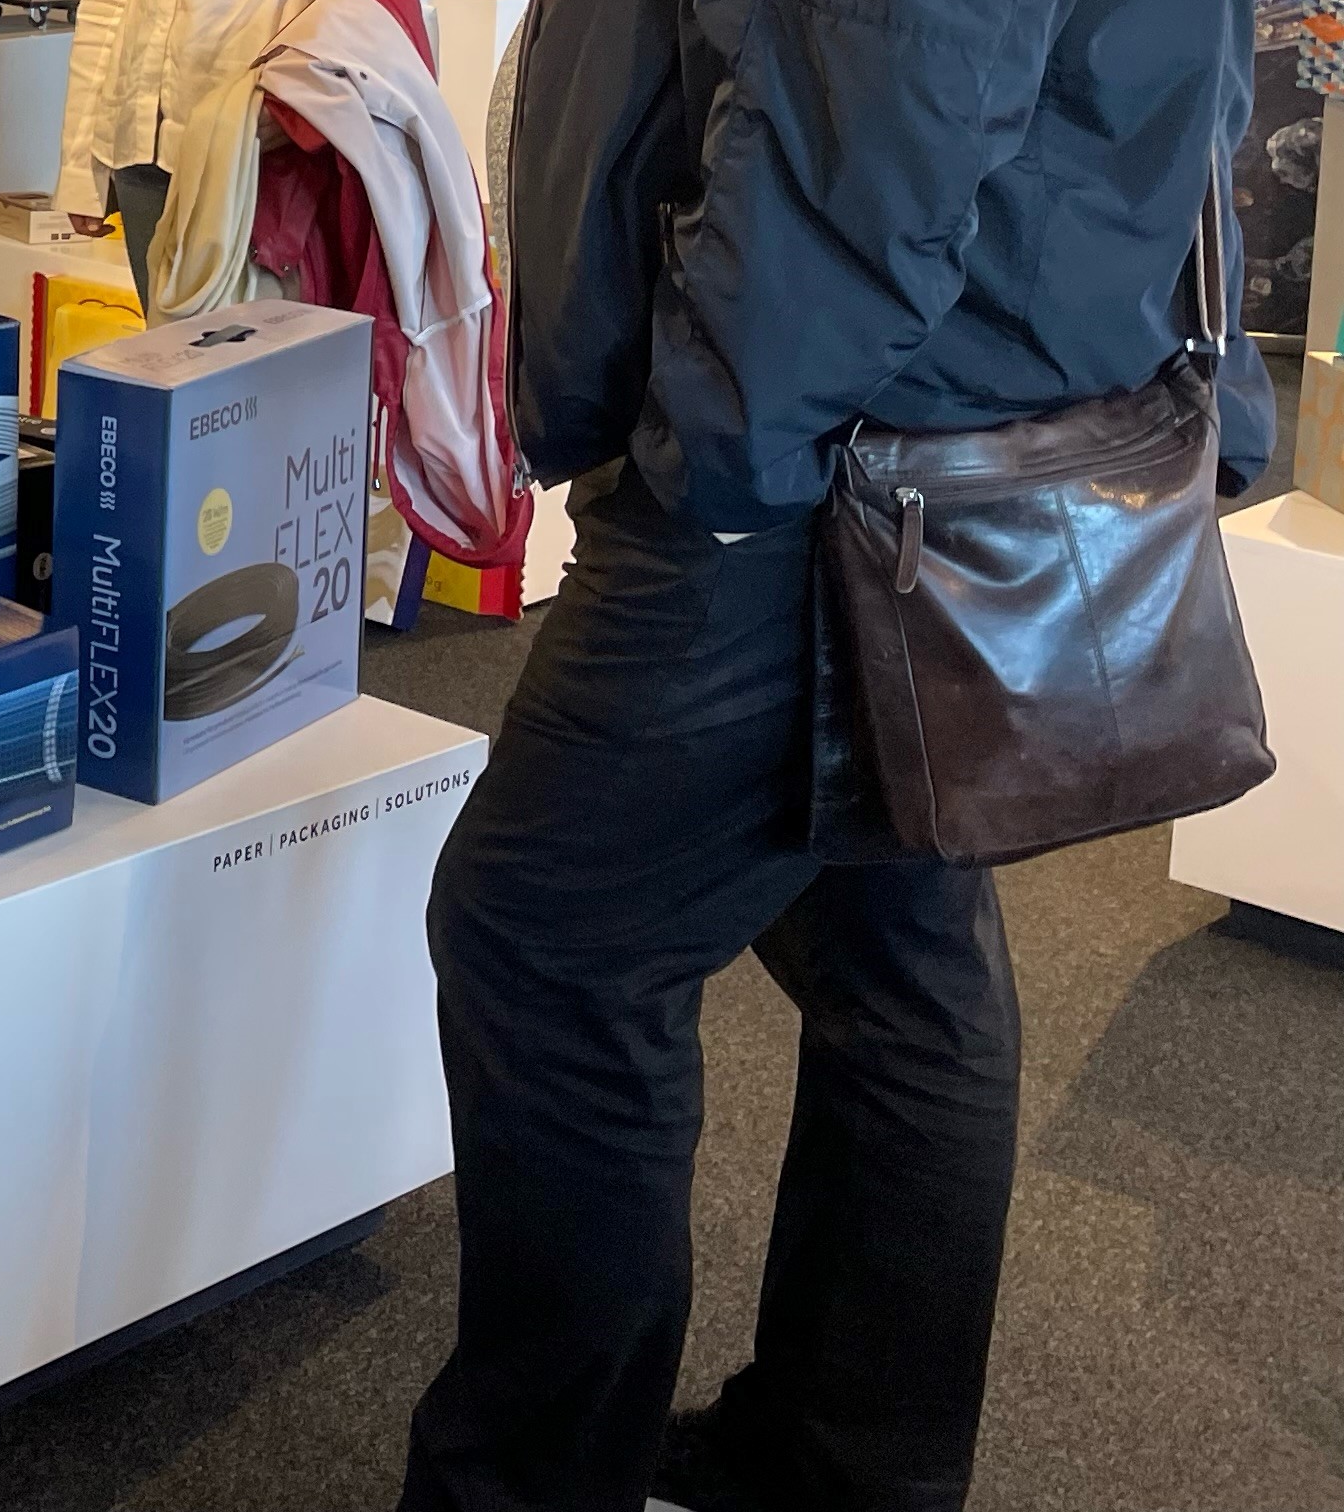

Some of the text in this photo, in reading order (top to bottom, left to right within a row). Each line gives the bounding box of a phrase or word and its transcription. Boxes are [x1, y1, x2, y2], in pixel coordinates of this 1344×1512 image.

[100, 415, 118, 488] EBECO
[190, 401, 242, 441] EBECO
[285, 428, 356, 510] Multi
[274, 492, 355, 571] FLEX
[310, 557, 351, 624] 20
[87, 534, 122, 760] MultiFLEX20
[213, 769, 470, 873] PAPER PACKAGING SOLUTIONS
